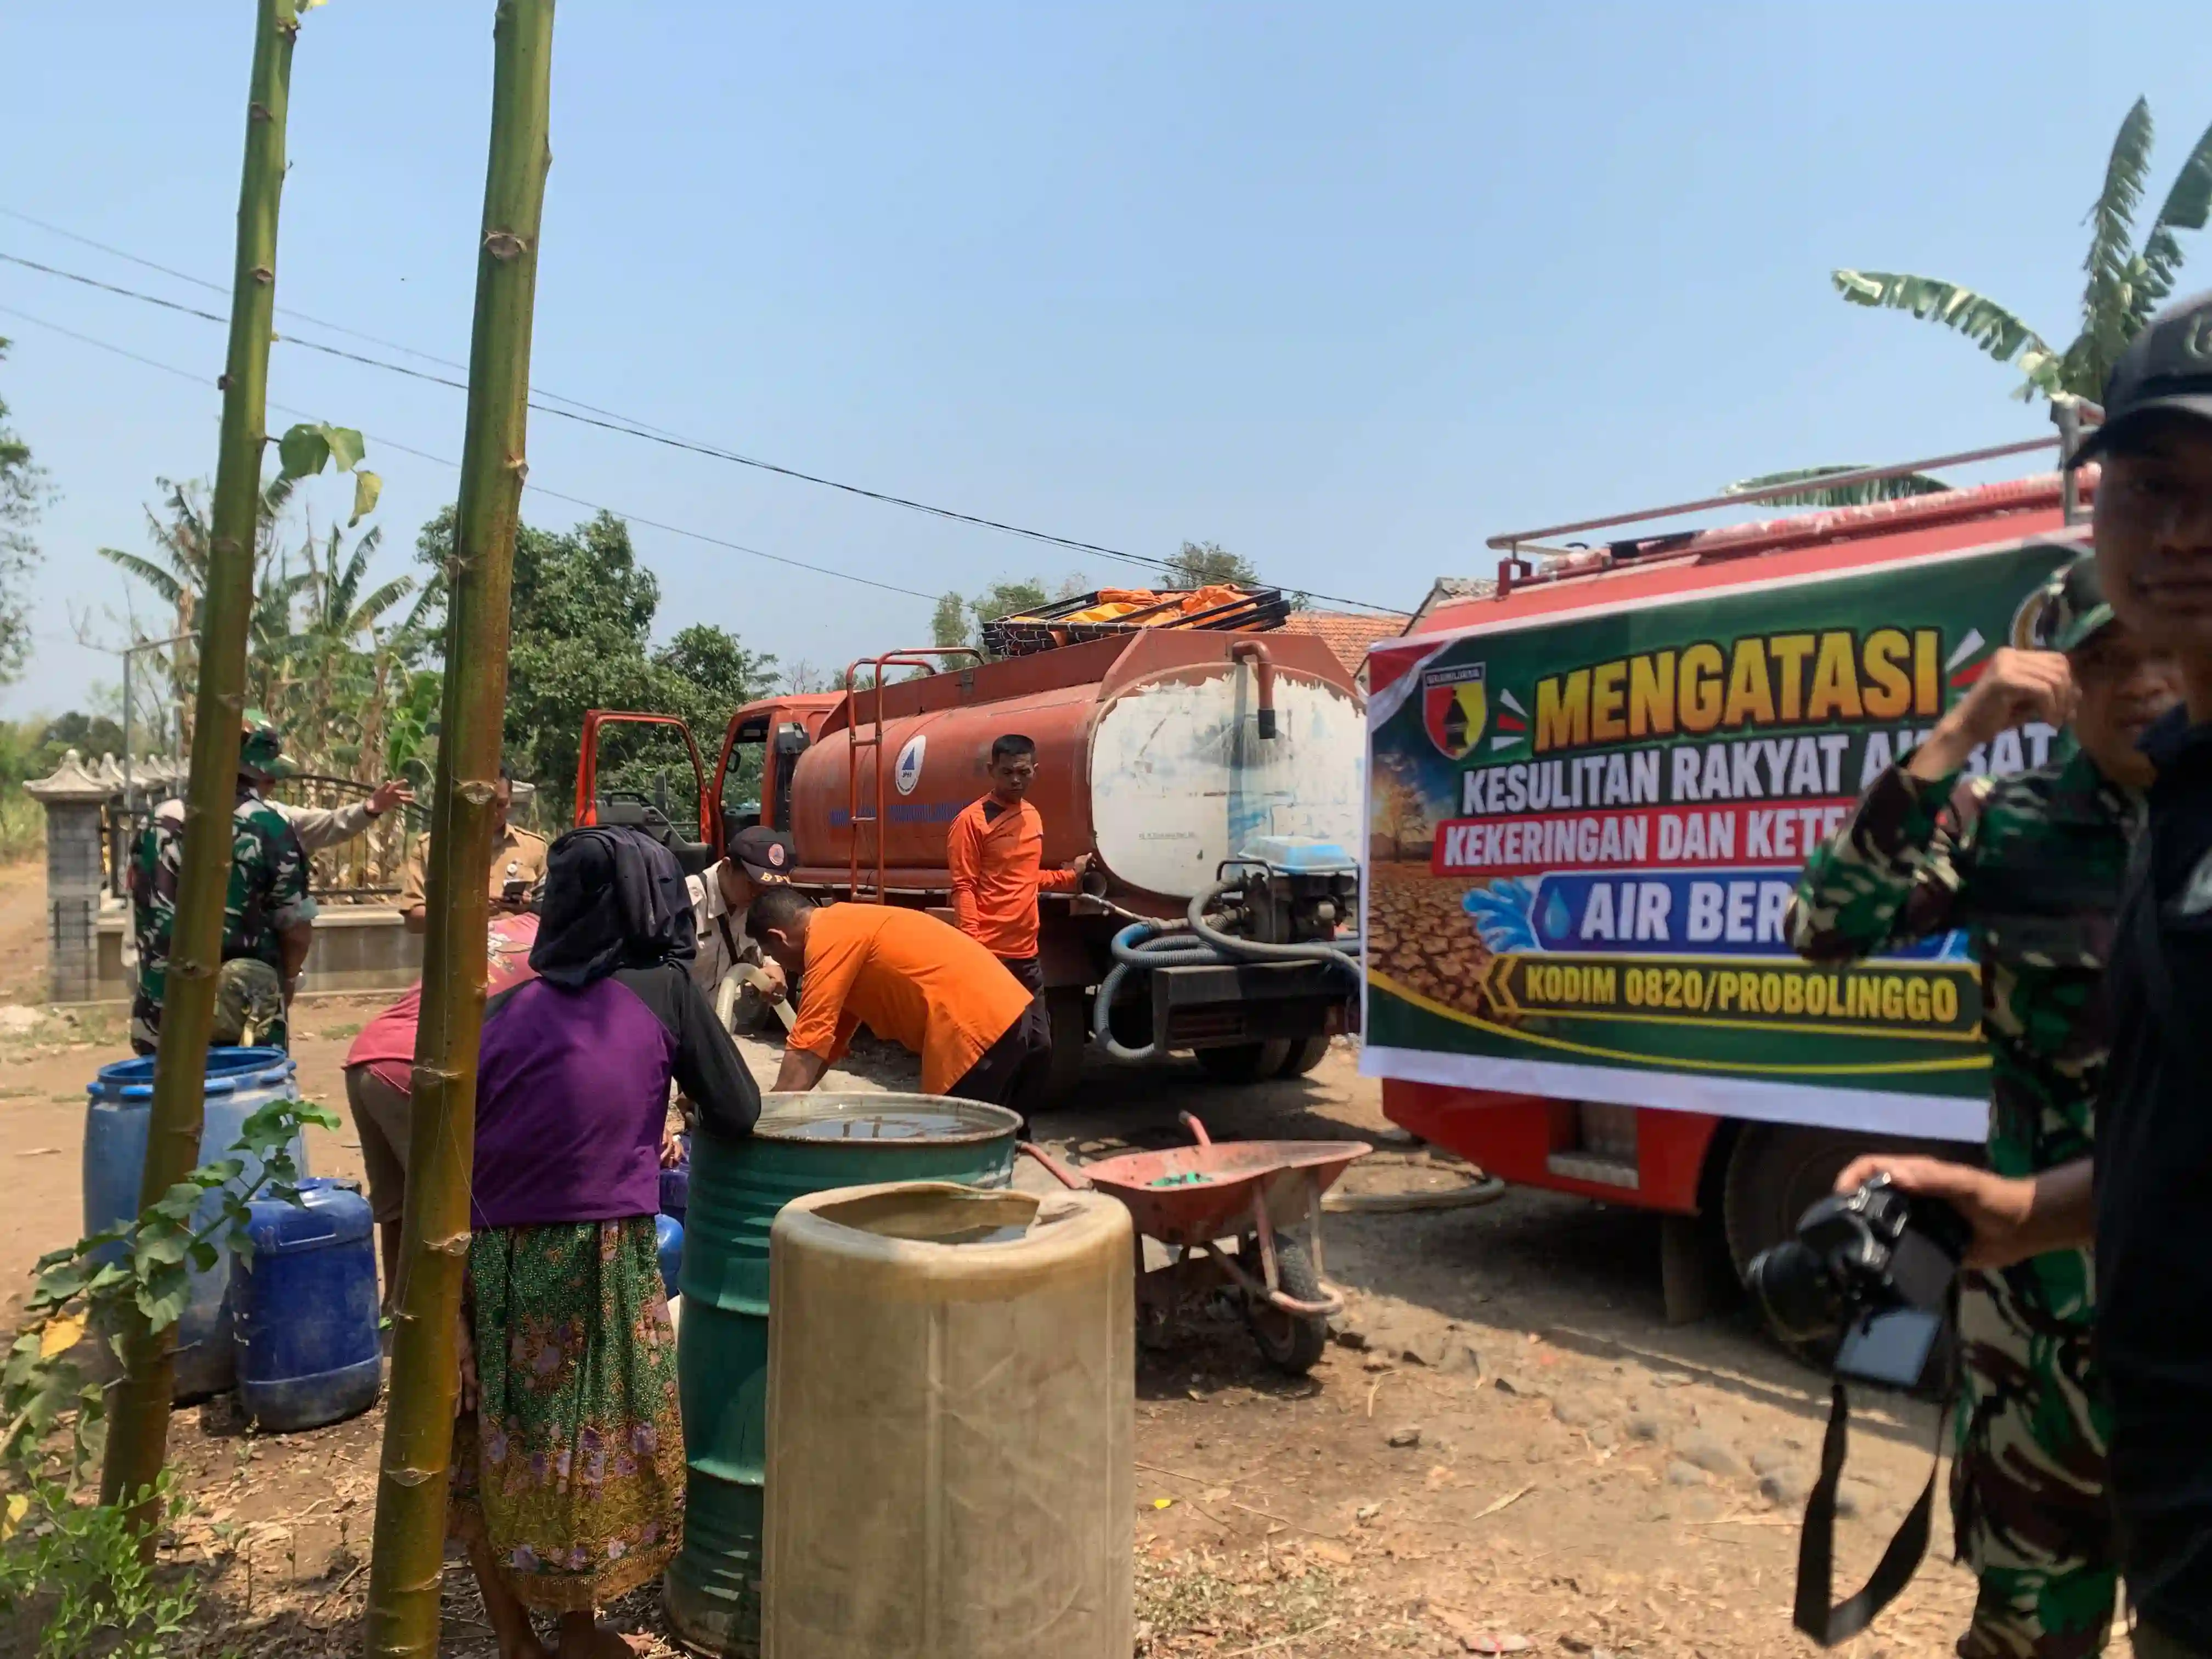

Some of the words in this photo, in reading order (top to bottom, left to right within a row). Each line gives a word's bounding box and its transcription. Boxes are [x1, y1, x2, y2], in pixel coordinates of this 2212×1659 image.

[1534, 628, 1938, 752] MENGATASI
[1462, 749, 1661, 815] KESULITAN
[1671, 733, 1849, 802] RAKYAT
[1860, 721, 2058, 790] AAT
[1444, 815, 1648, 867] KEKERINGAN
[1657, 810, 1736, 861] DAN
[1746, 805, 1853, 860] KETE
[1579, 882, 1670, 941] AIR
[1686, 881, 1793, 943] BER
[1525, 964, 1616, 1005] KODIM
[1624, 967, 1959, 1023] 0820/PROBOLINGGO
